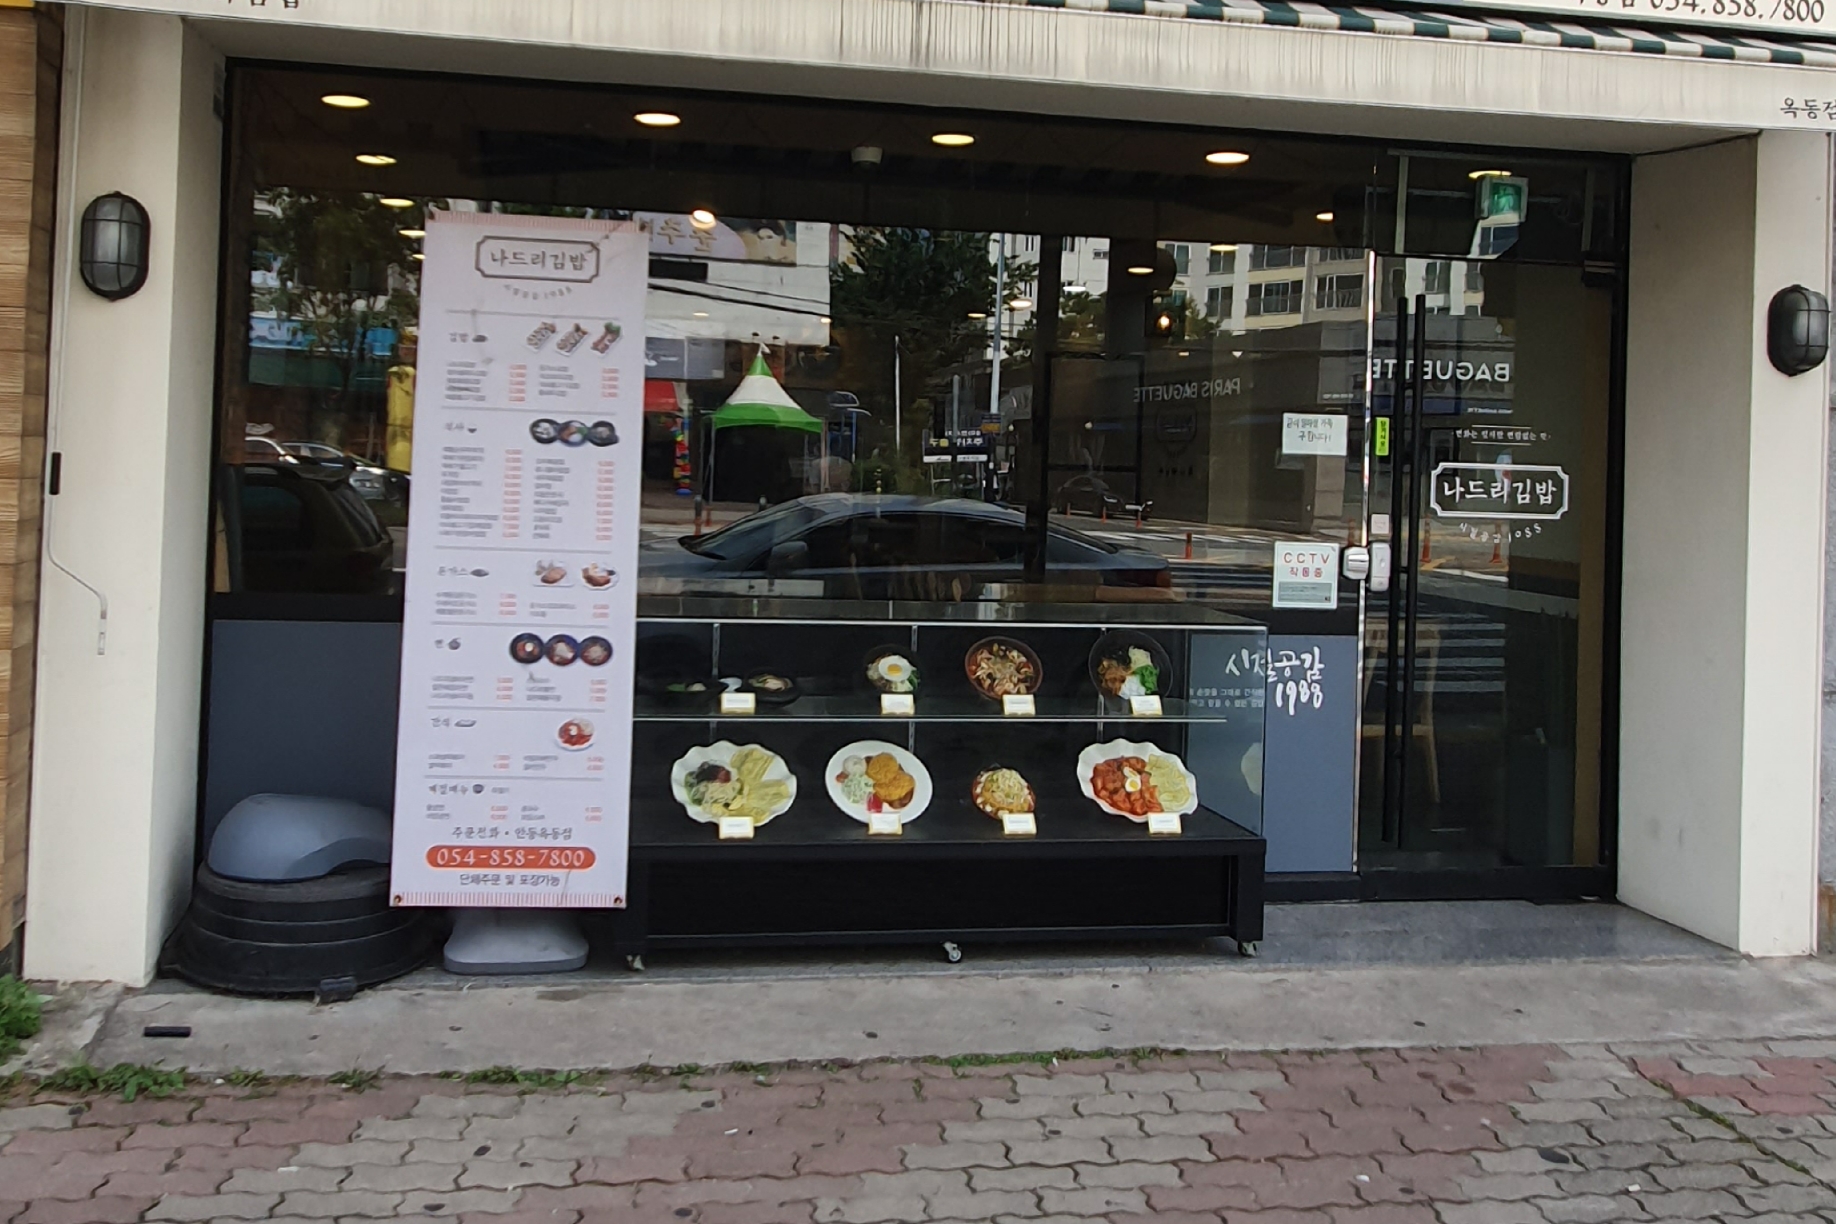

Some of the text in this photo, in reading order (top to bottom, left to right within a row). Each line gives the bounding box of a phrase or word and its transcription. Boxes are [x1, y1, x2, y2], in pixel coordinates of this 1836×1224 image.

[490, 248, 588, 271] 나드리김밥
[1442, 474, 1557, 507] 나드리김밥
[1283, 551, 1330, 565] CCTV
[1274, 679, 1324, 716] 1988
[451, 827, 500, 840] 주문전화
[436, 848, 585, 867] 054-858-7800
